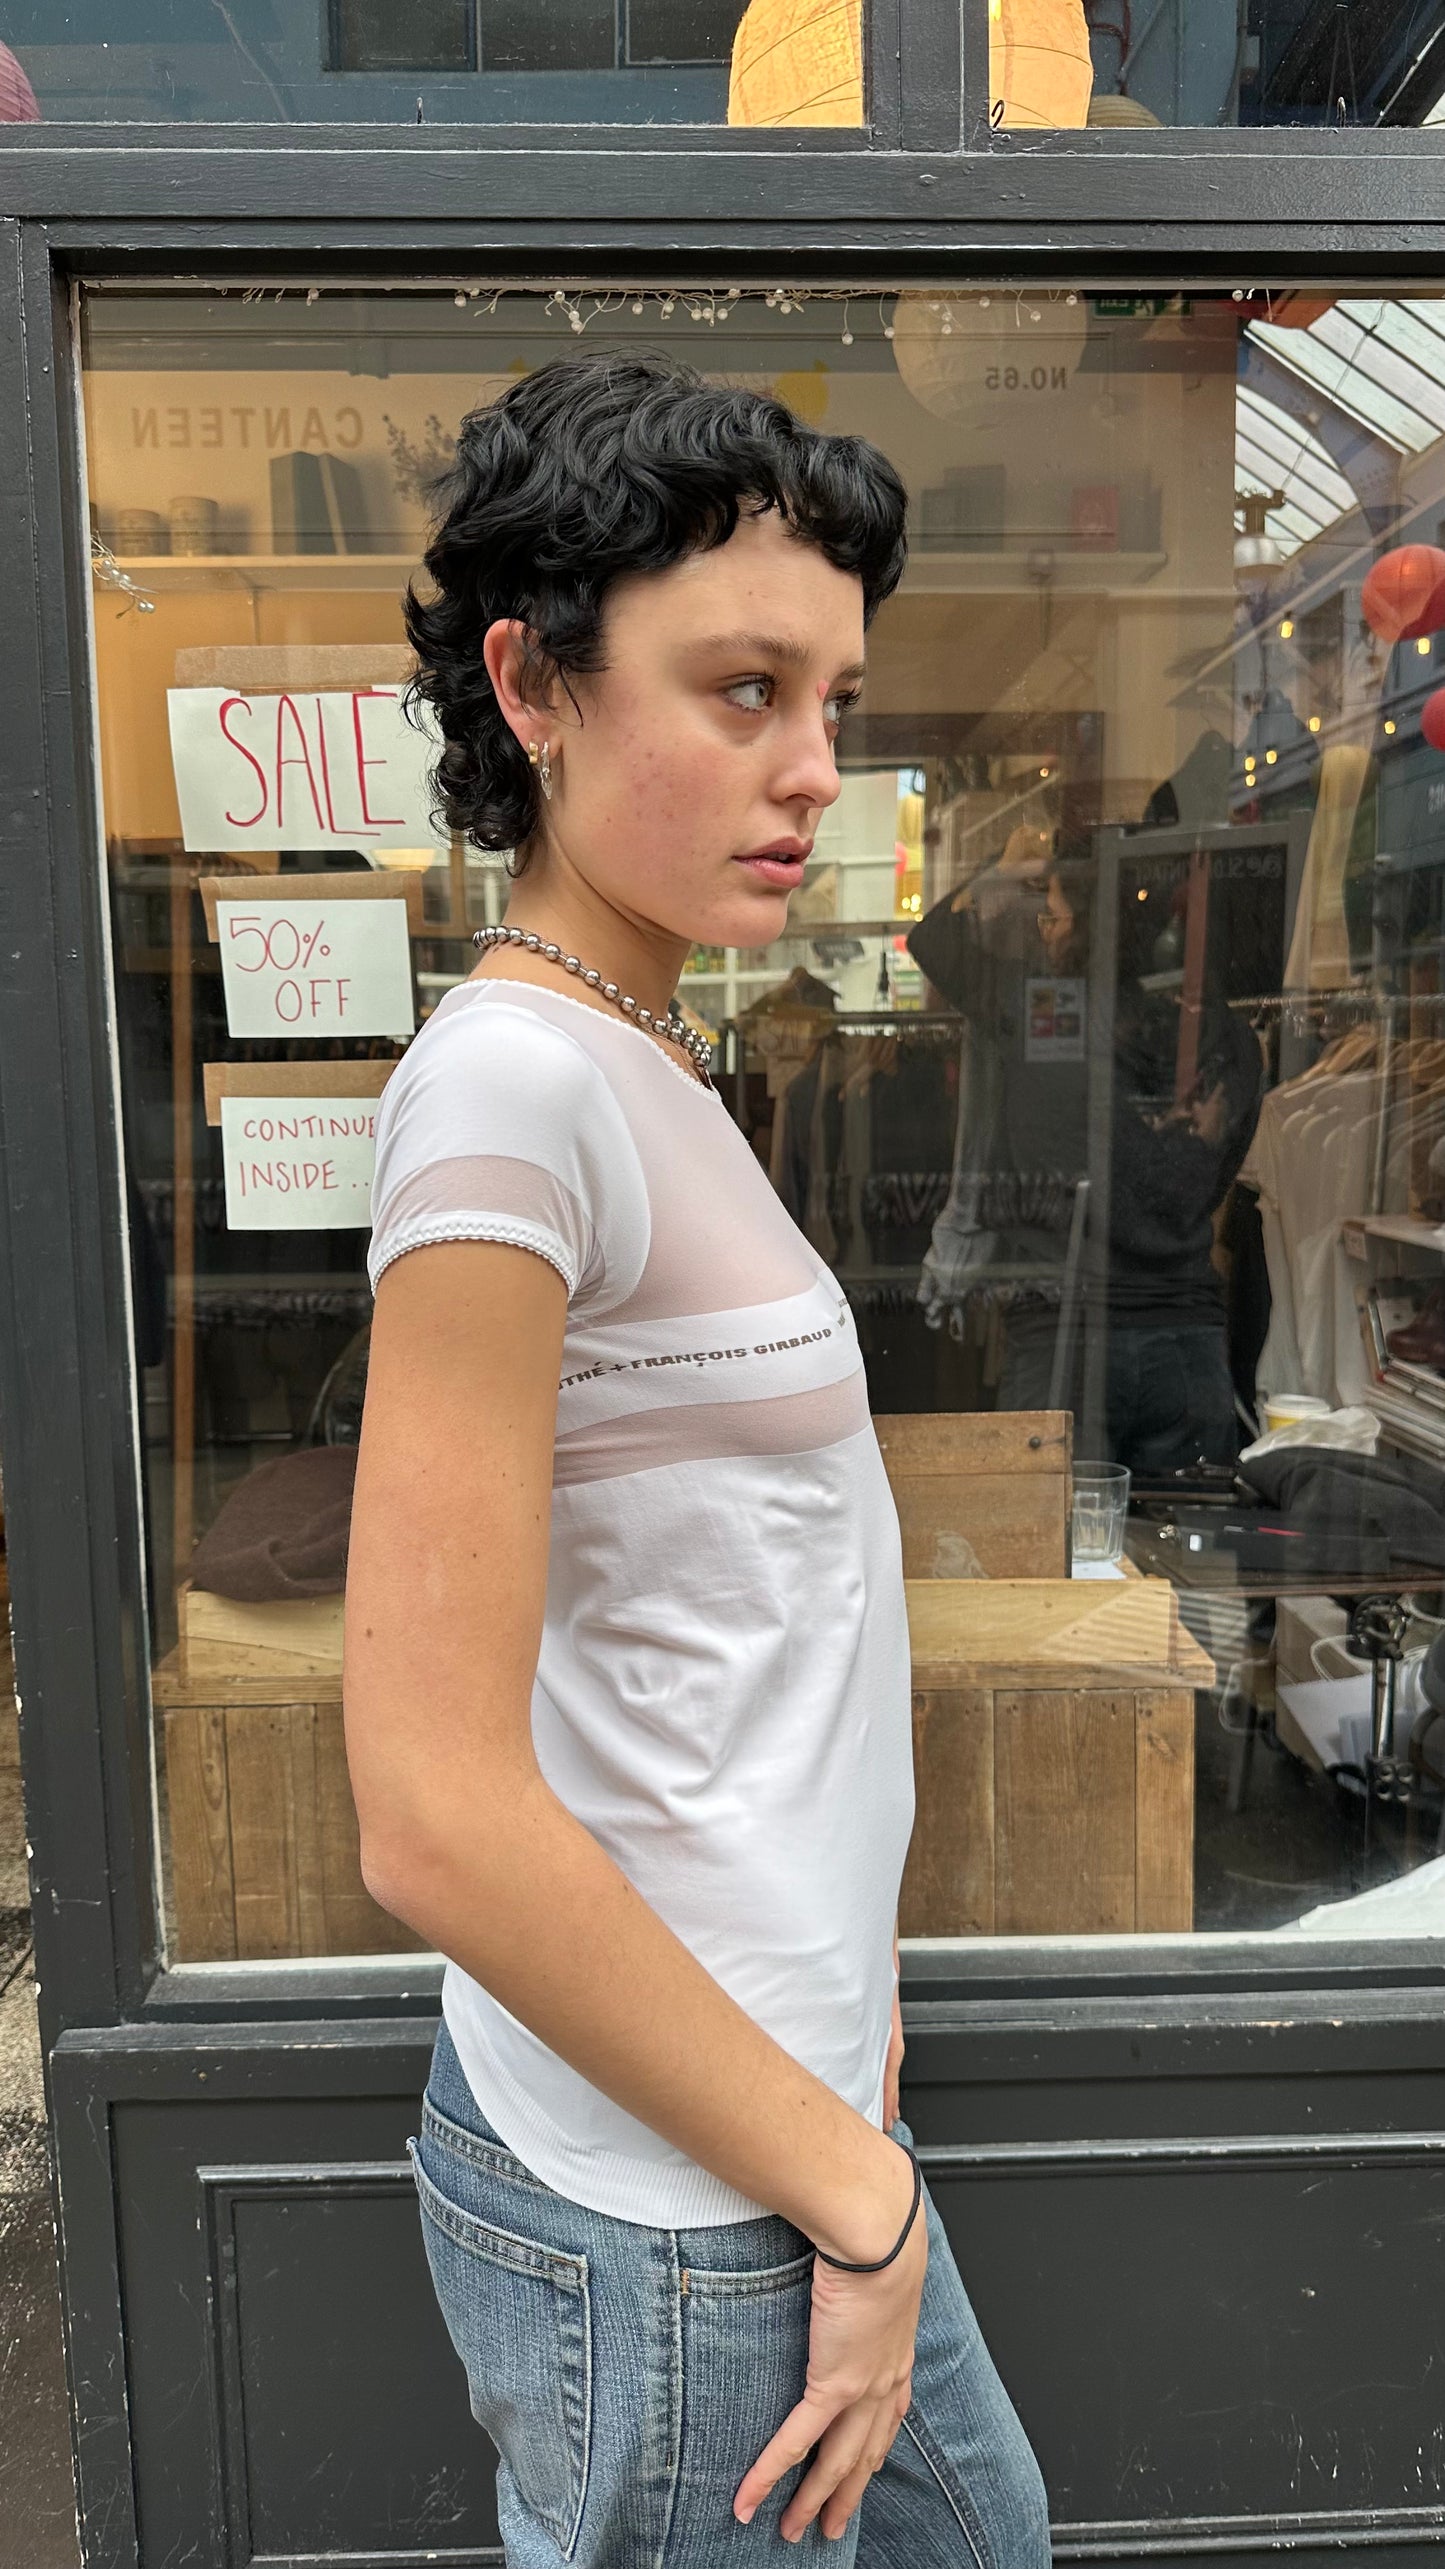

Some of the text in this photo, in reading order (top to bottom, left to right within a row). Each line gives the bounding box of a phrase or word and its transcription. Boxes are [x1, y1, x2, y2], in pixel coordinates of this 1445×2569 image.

[219, 692, 406, 836] SALE
[230, 917, 330, 972] 50%
[276, 980, 351, 1022] OFF
[631, 1348, 748, 1369] FRANÇOIS
[753, 1328, 832, 1354] GIRBAUD
